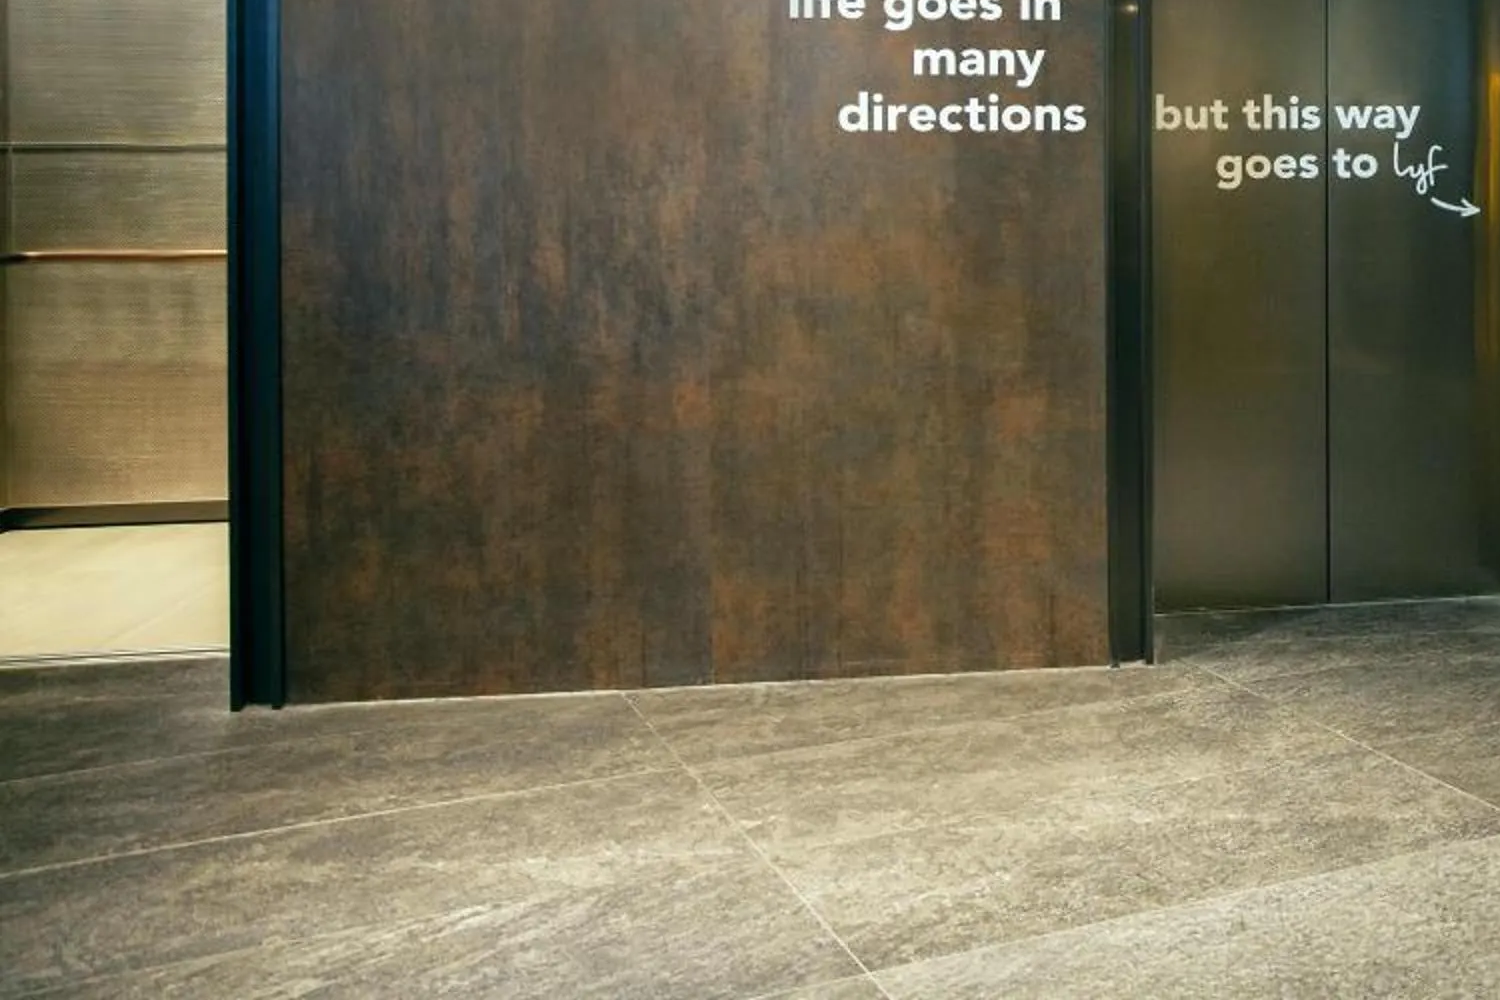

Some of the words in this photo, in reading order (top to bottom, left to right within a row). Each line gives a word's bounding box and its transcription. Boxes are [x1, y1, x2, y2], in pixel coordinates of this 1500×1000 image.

[912, 47, 1046, 88] many
[837, 90, 1087, 132] directions
[1155, 93, 1230, 131] but
[1241, 93, 1322, 131] this
[1334, 104, 1421, 139] way
[1216, 152, 1320, 189] goes
[1331, 147, 1379, 180] to
[1393, 140, 1449, 196] lyf
